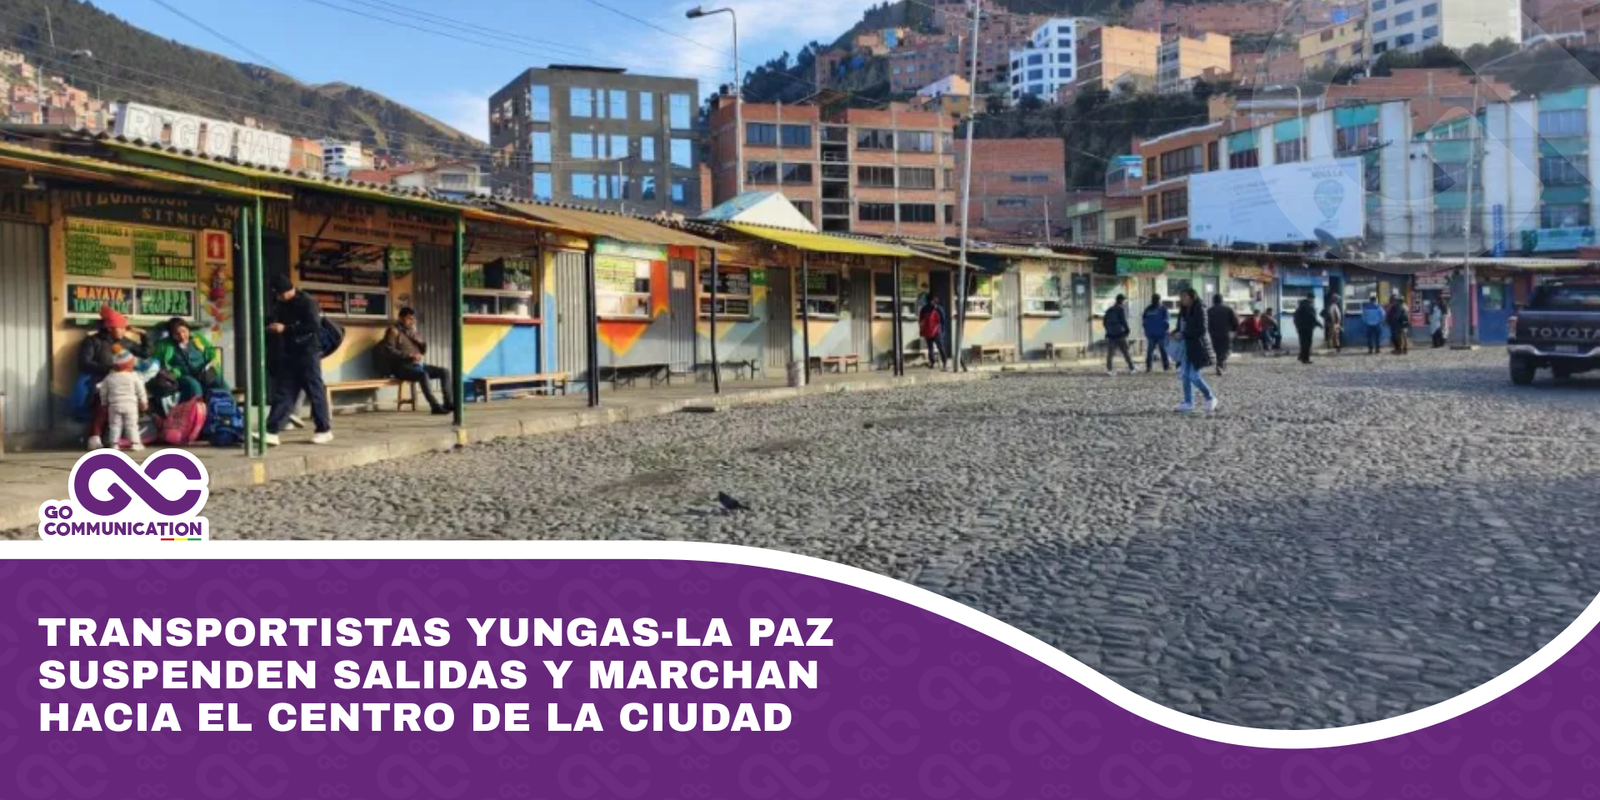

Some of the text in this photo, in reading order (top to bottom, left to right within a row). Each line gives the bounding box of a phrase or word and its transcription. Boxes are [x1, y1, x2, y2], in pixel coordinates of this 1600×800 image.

[142, 207, 232, 230] SITMICAR
[76, 286, 123, 301] MAYAYA
[1529, 327, 1600, 340] TOYOTA
